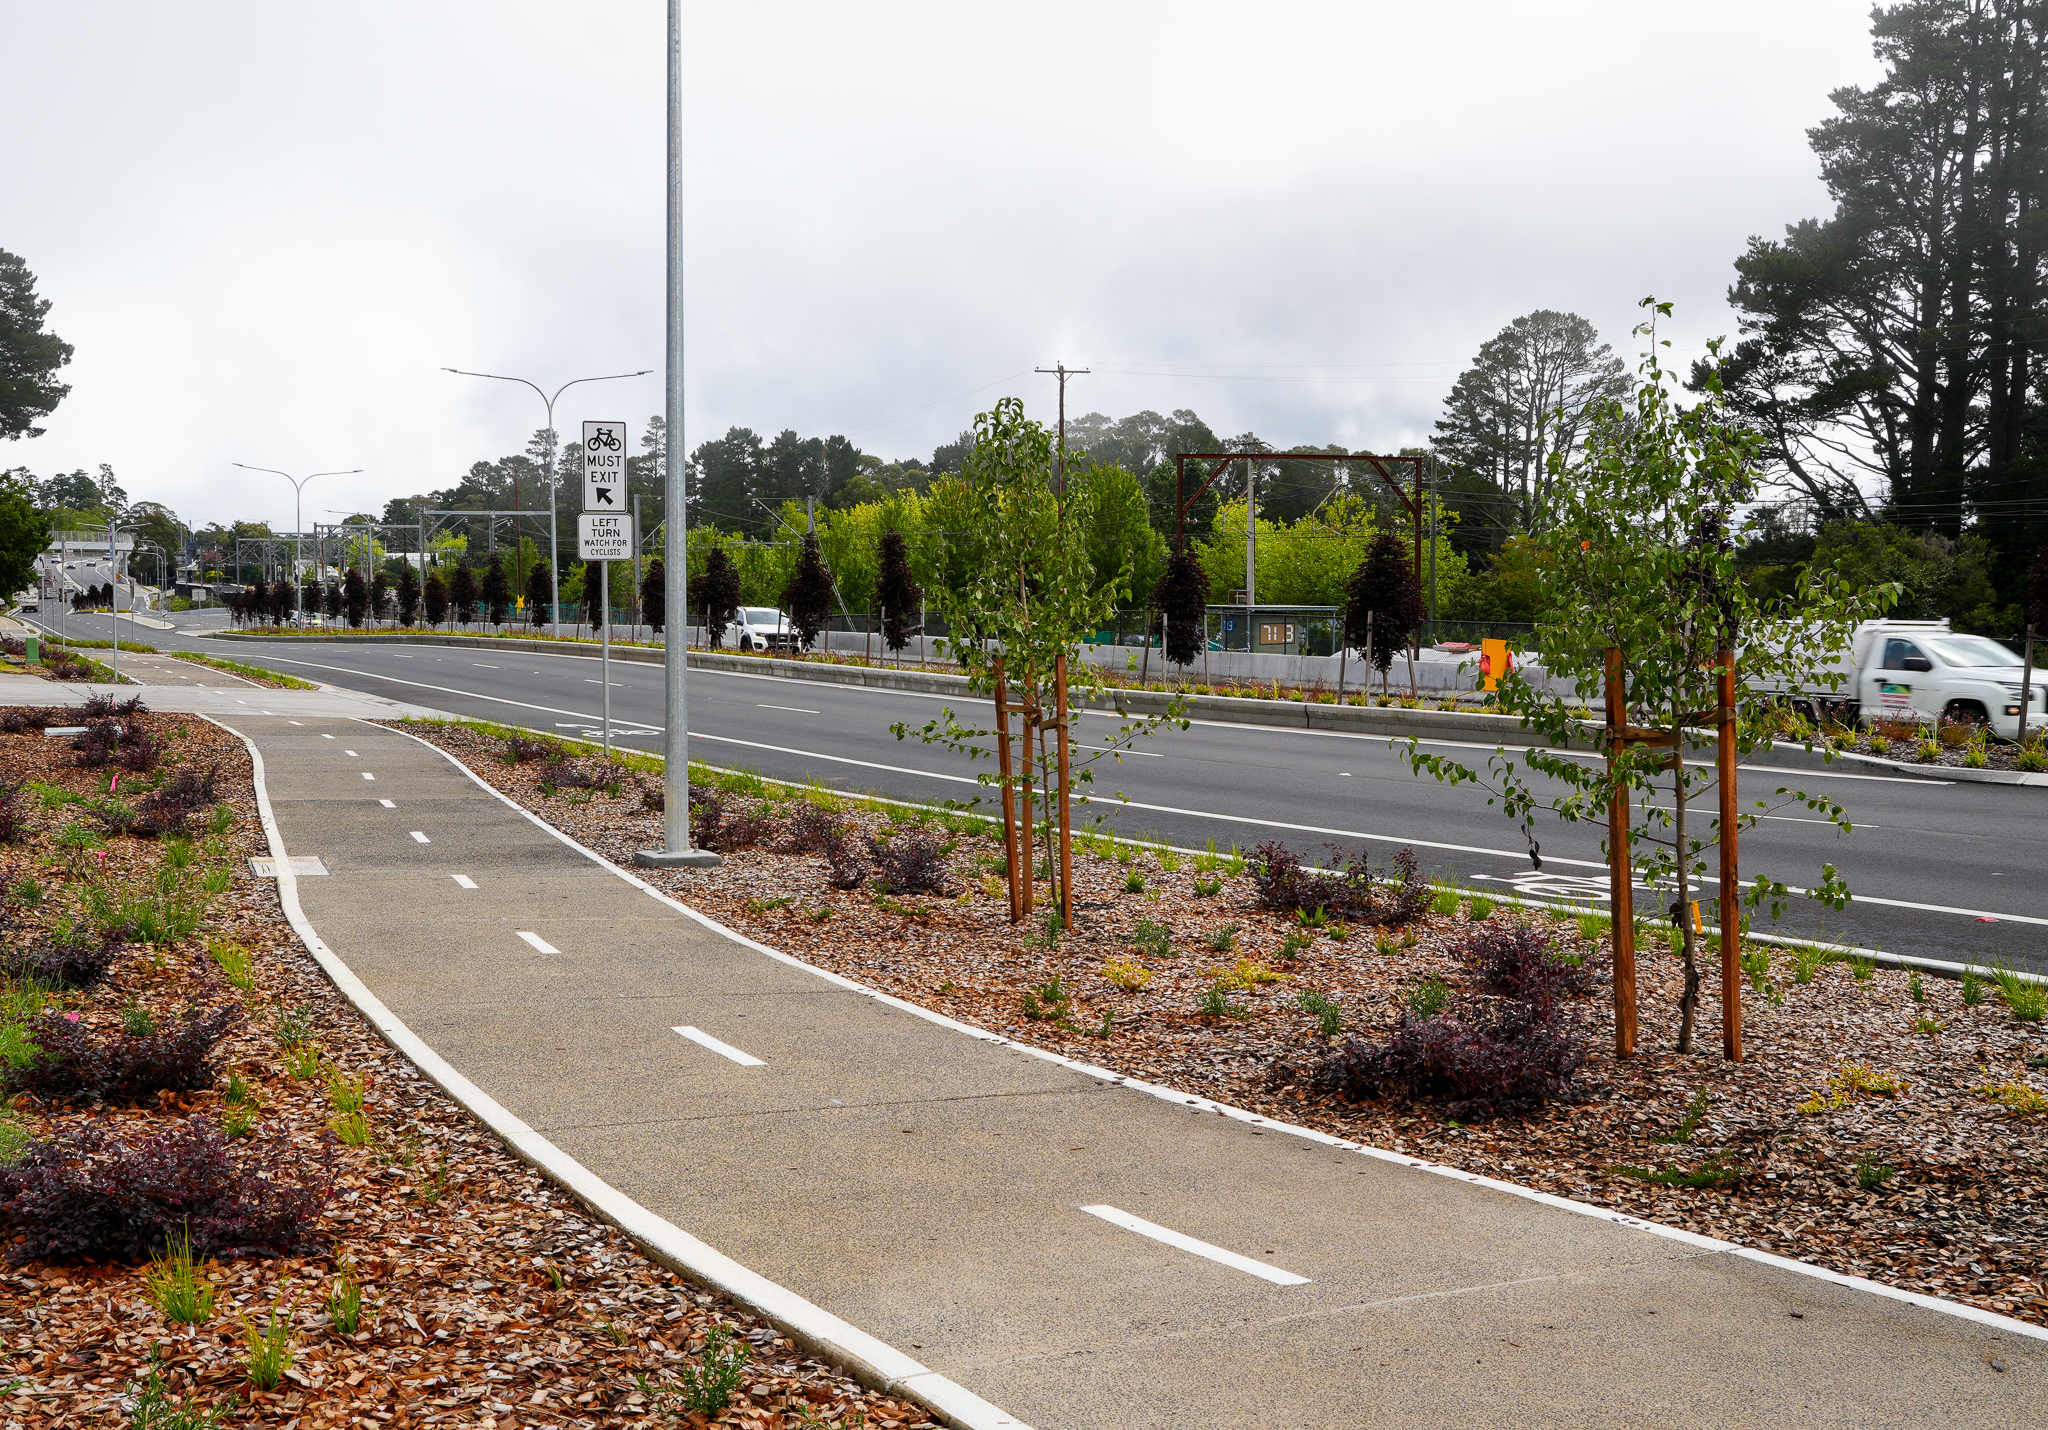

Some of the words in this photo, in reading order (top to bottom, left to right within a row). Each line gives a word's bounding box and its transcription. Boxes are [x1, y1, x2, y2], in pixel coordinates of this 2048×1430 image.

[587, 455, 622, 467] MUST
[590, 471, 618, 483] EXIT
[592, 518, 619, 527] LEFT
[591, 529, 620, 537] TURN
[584, 539, 610, 547] WATCH
[612, 539, 628, 547] FOR
[590, 548, 621, 556] CYCLISTS
